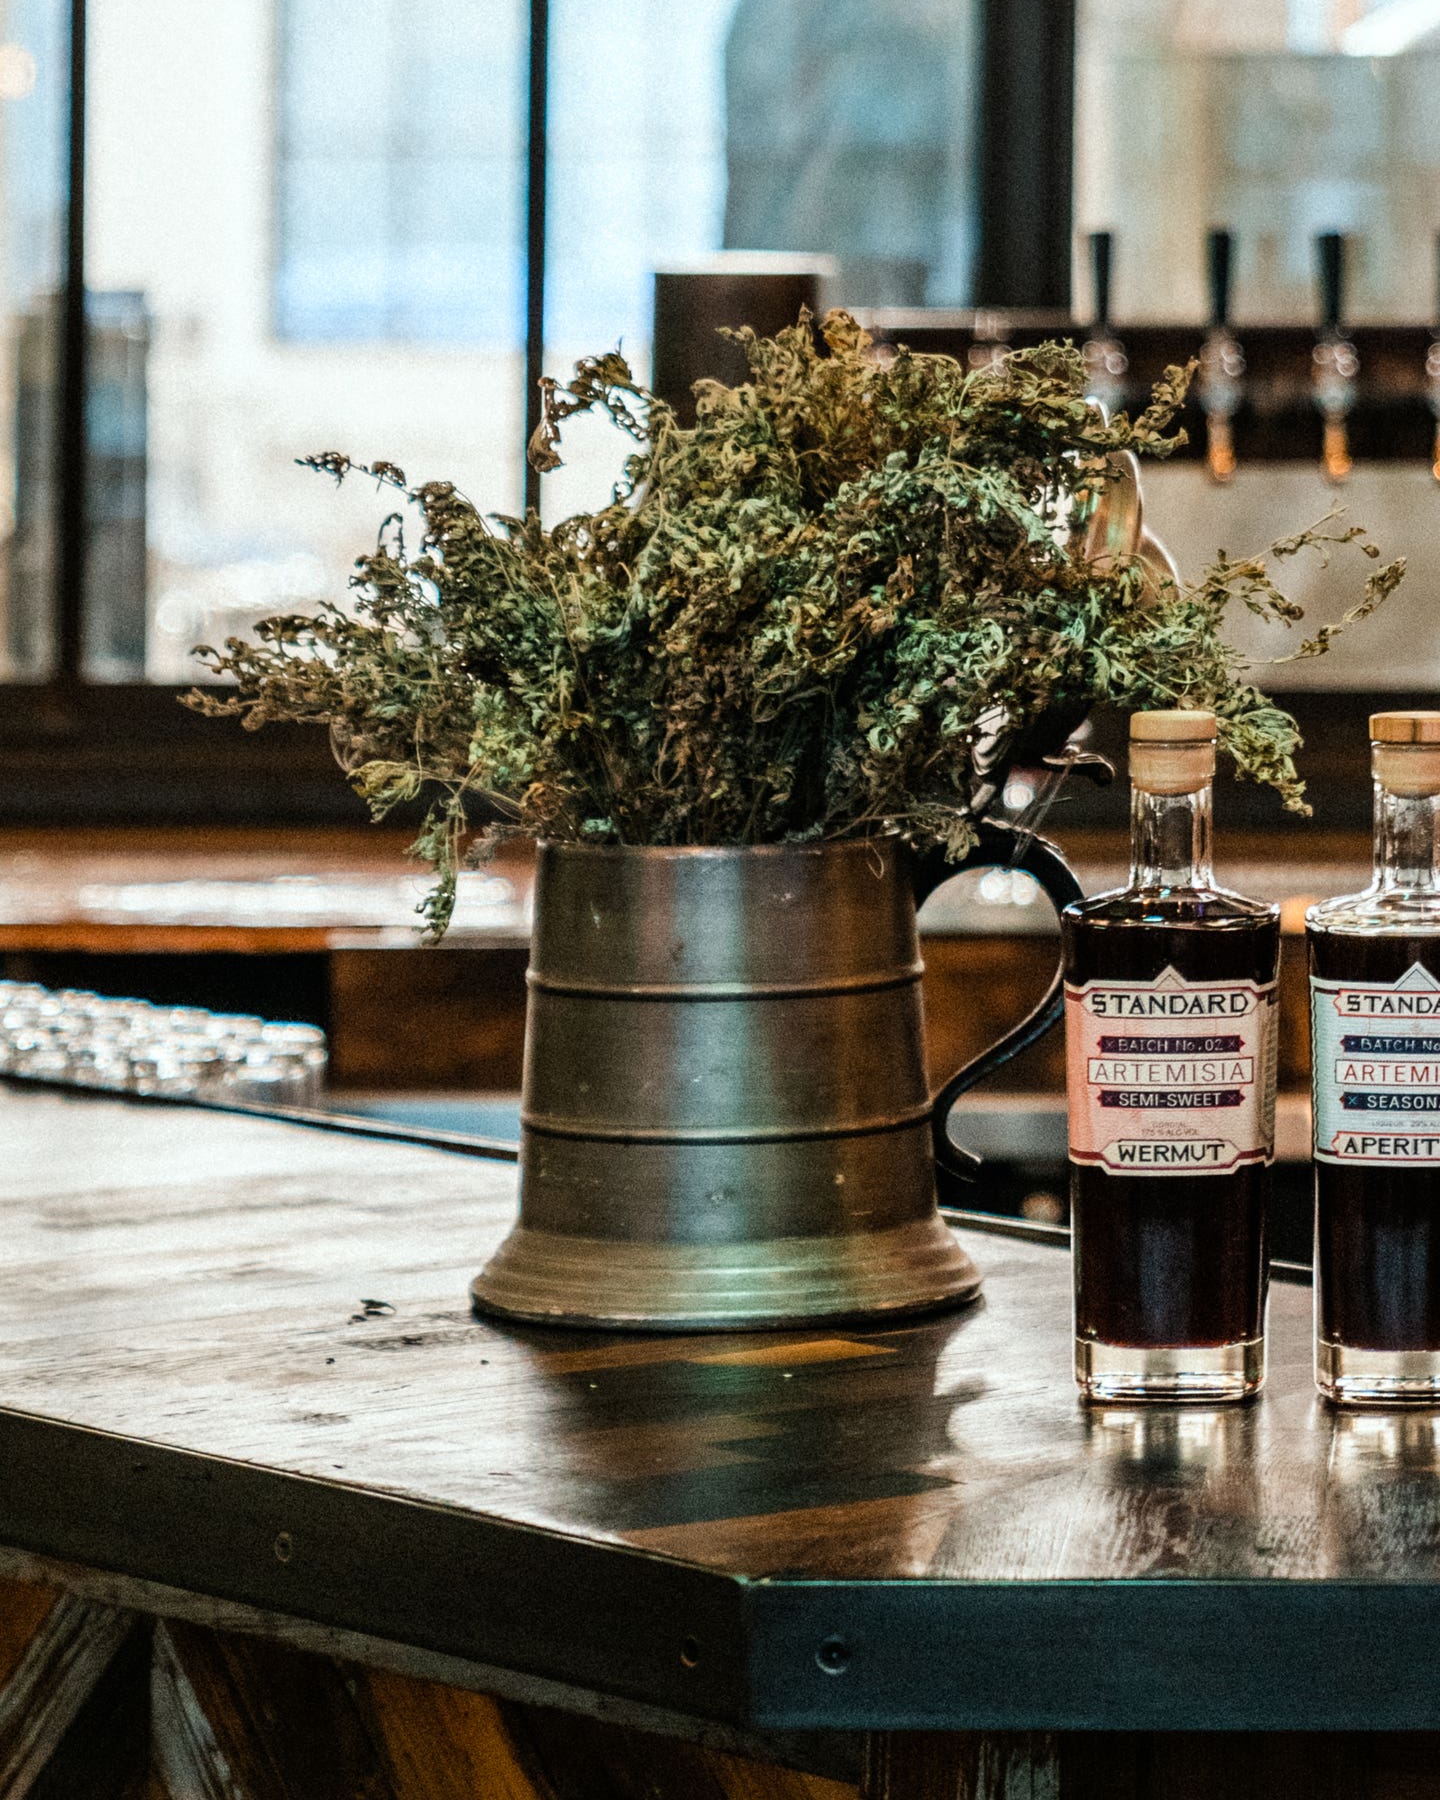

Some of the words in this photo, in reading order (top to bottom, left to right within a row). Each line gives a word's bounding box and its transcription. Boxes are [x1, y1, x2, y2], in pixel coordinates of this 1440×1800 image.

[1091, 993, 1249, 1015] STANDARD
[1118, 1039, 1168, 1052] BATCH
[1360, 1038, 1415, 1051] BATCH
[1094, 1062, 1245, 1082] ARTEMISIA
[1119, 1092, 1222, 1107] SEMI-SWEET
[1118, 1144, 1225, 1162] WERMUT
